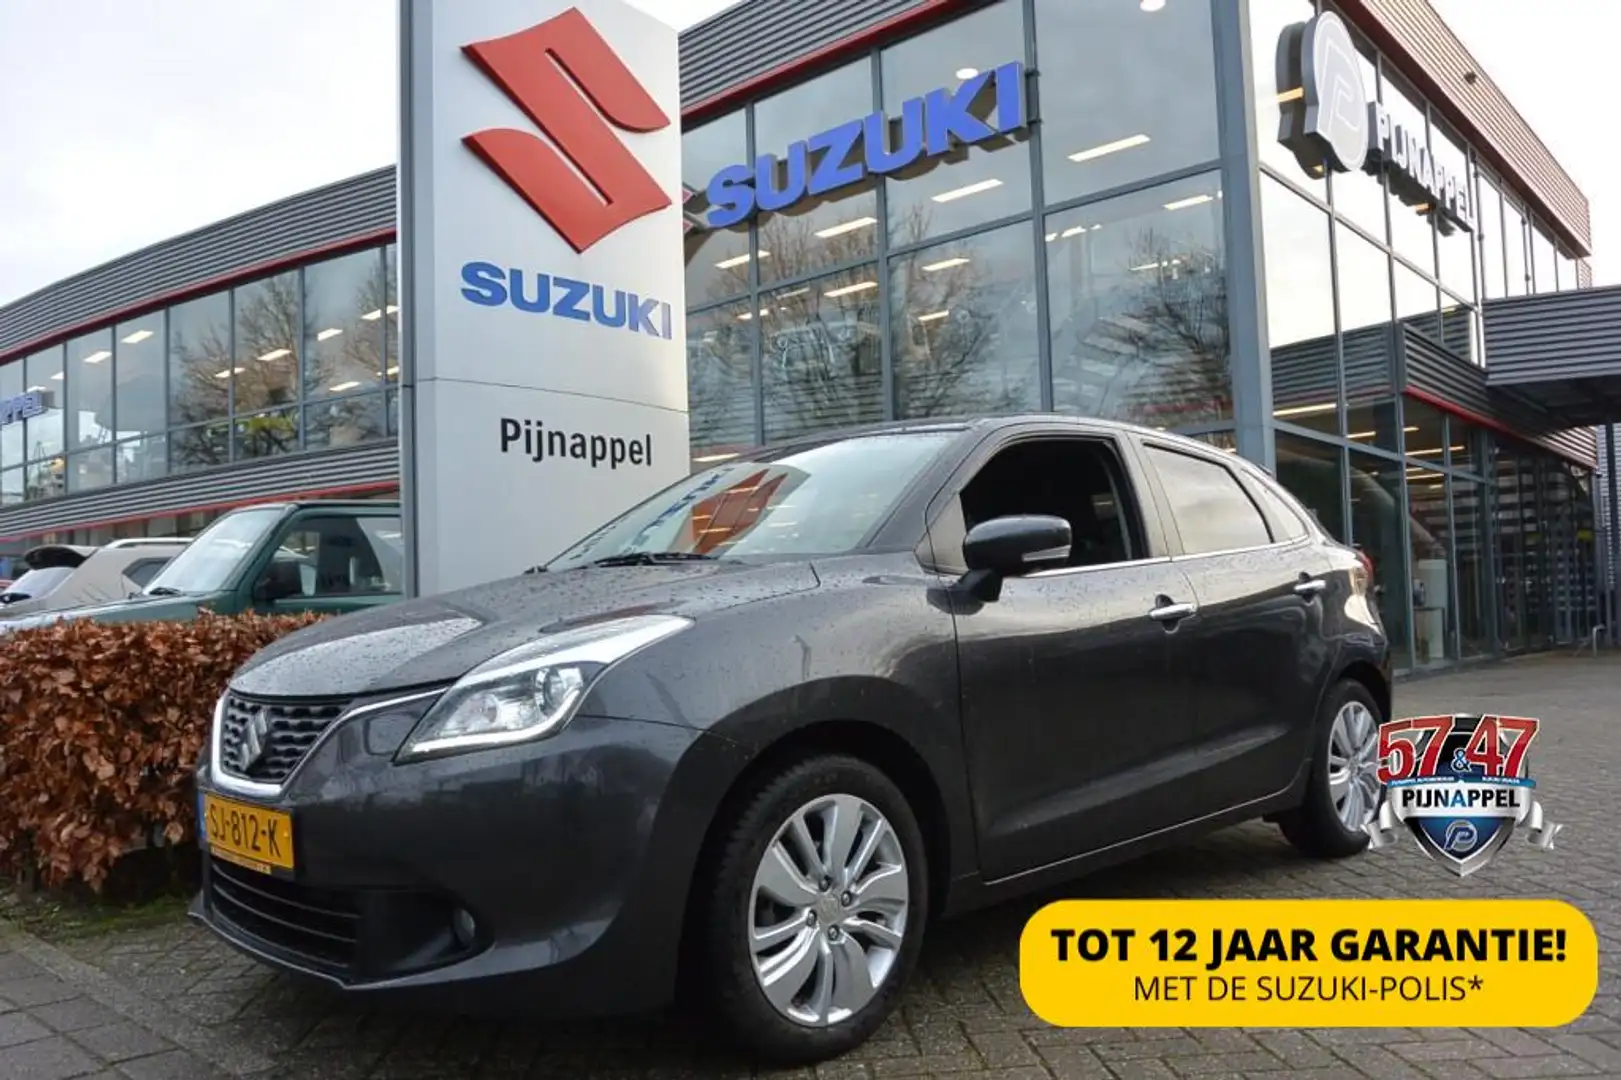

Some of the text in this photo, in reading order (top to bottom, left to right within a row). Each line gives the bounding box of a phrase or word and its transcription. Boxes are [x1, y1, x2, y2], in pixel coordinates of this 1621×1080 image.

[706, 60, 1024, 230] SUZUKI
[461, 262, 672, 340] SUZUKI
[501, 418, 651, 469] Pijnappel
[209, 803, 281, 858] SJ-812-K
